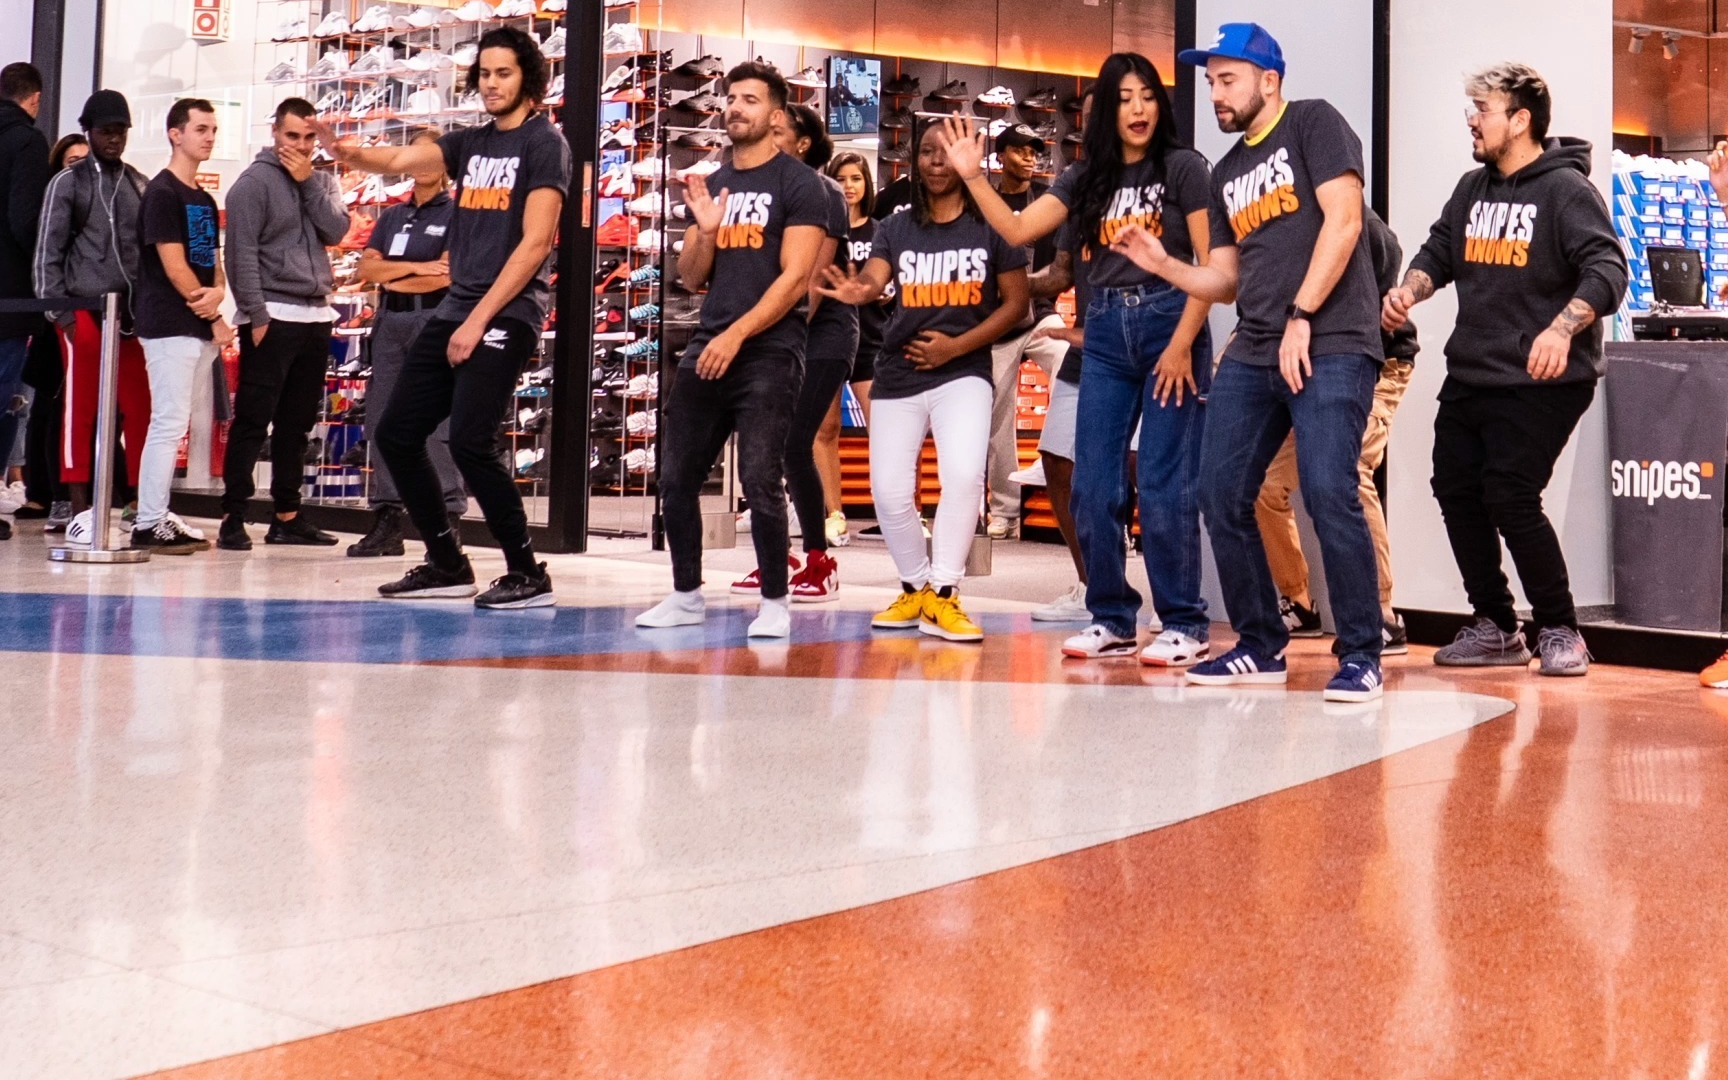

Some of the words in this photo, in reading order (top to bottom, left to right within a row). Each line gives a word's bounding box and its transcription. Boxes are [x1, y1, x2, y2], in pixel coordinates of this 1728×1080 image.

[1222, 146, 1295, 219] SNIPES
[716, 223, 765, 250] OWS
[1464, 236, 1530, 268] KNOWS
[897, 247, 989, 286] SNIPES
[901, 280, 984, 309] KNOWS
[1611, 459, 1701, 506] snipes
